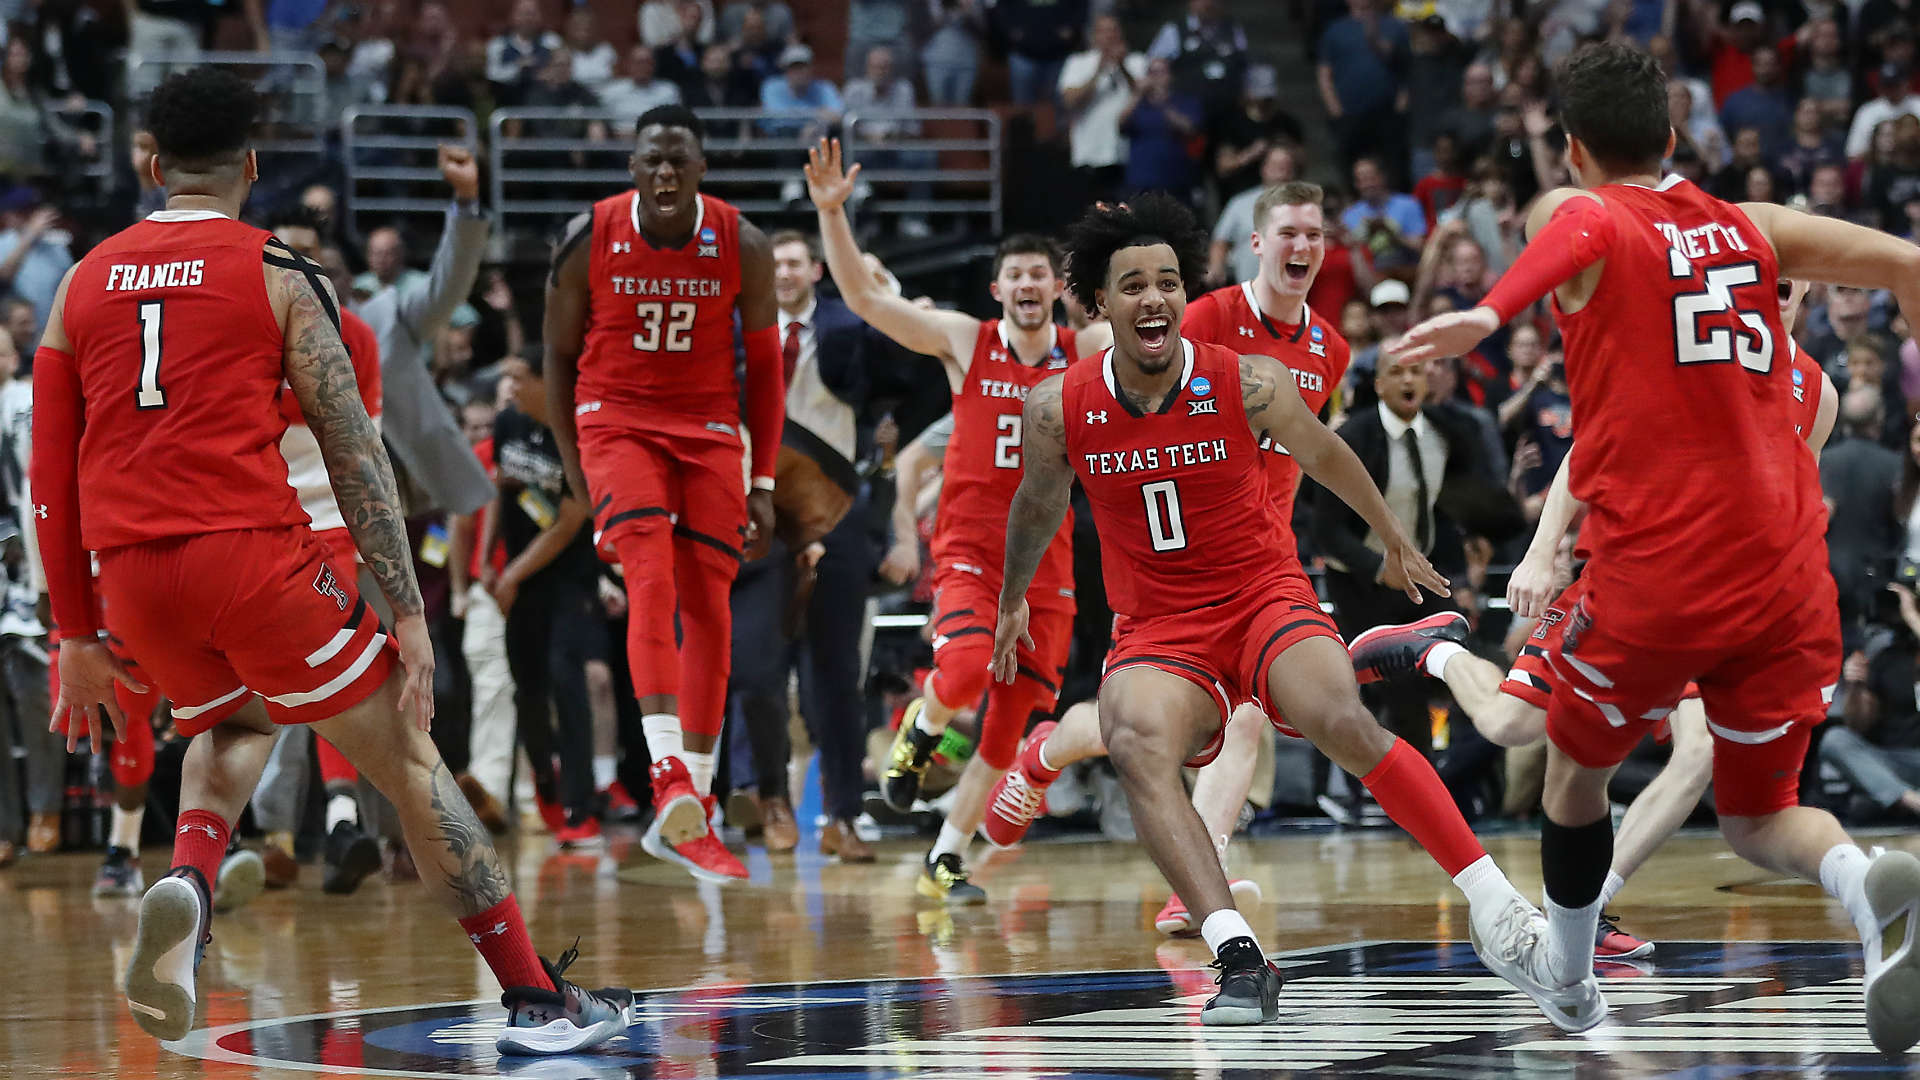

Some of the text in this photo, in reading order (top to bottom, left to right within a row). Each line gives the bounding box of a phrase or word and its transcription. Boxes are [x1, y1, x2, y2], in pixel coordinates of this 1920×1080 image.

[105, 259, 205, 291] FRANCIS
[612, 276, 721, 297] TEXAS TECH
[633, 302, 697, 352] 32
[1667, 246, 1774, 375] 25
[136, 301, 166, 409] 1
[980, 379, 1031, 402] TEXAS
[1289, 367, 1323, 392] TECH
[1084, 447, 1160, 475] TEXAS
[1164, 439, 1228, 468] TECH
[1141, 479, 1187, 552] 0
